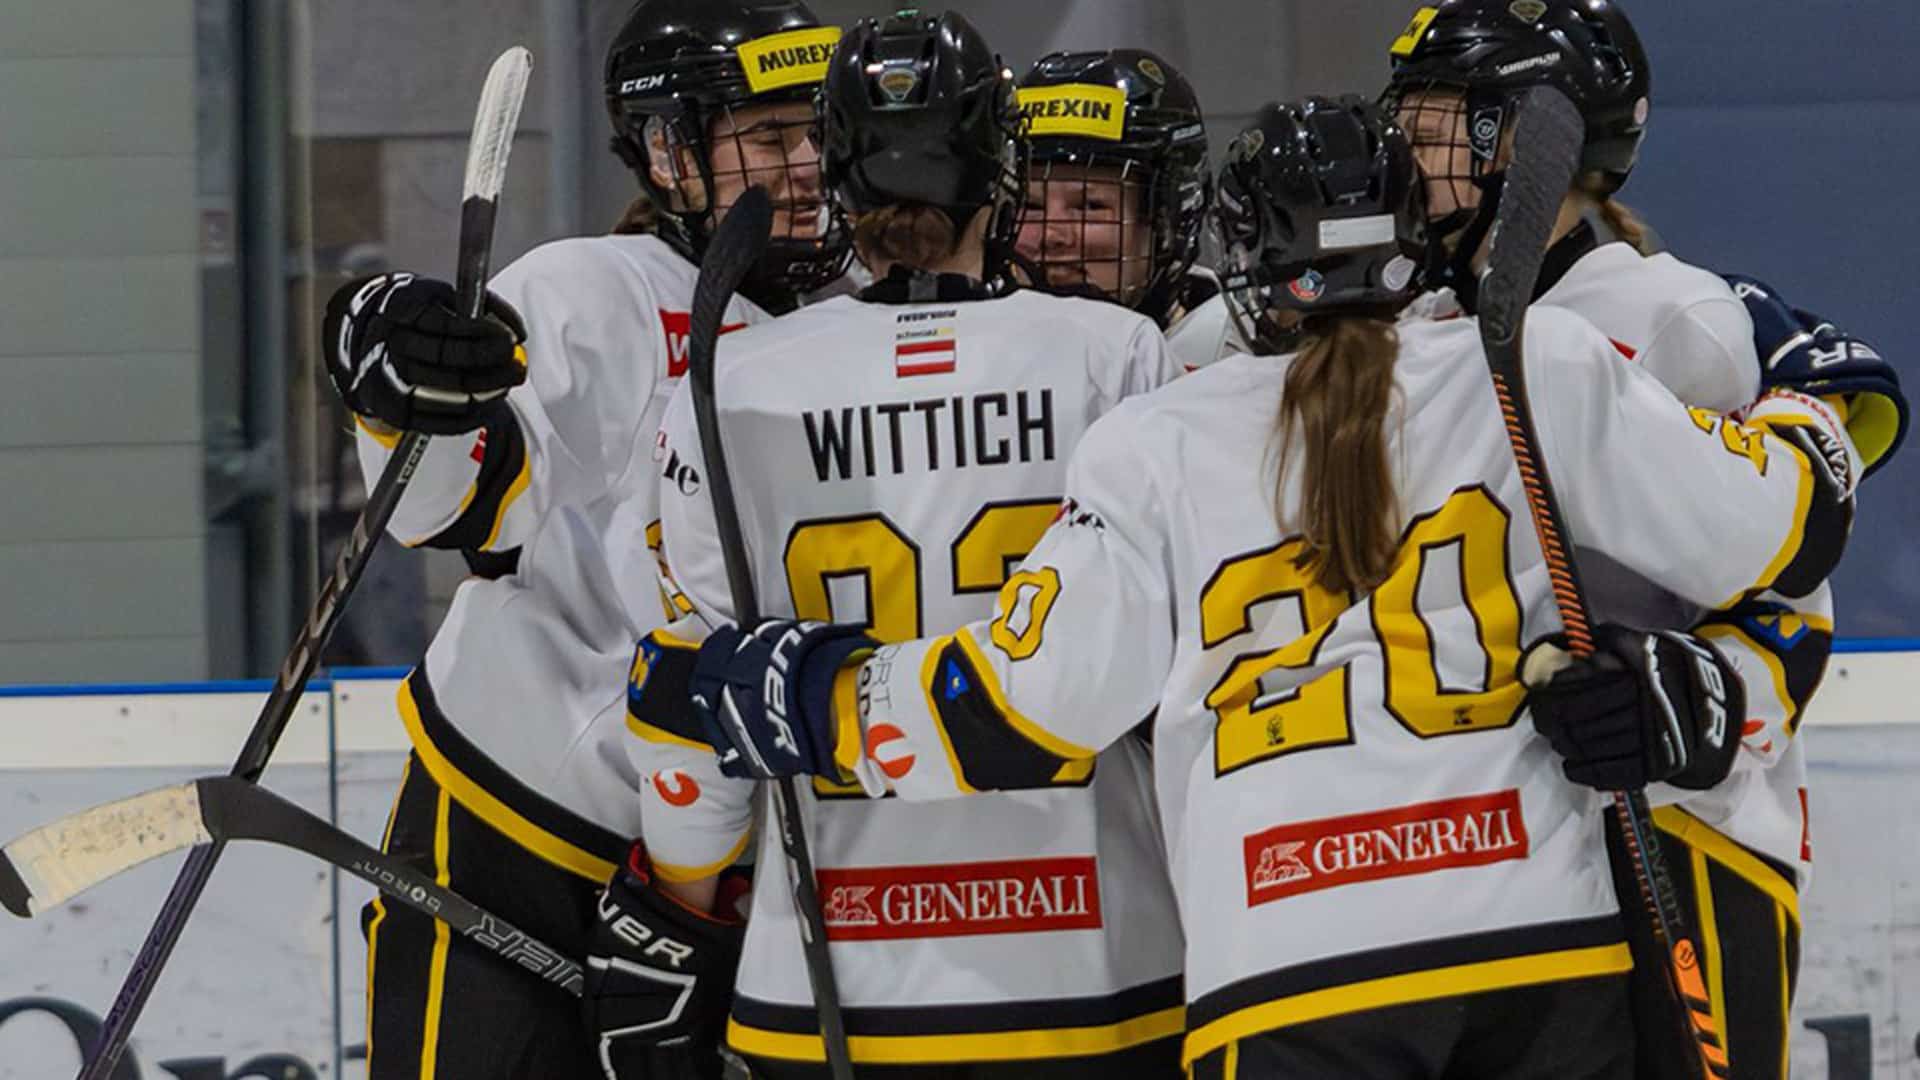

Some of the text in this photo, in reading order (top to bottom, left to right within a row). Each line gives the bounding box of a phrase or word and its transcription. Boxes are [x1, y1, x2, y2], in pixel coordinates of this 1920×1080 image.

[620, 74, 664, 93] CCM
[757, 43, 839, 73] MUREX
[1020, 98, 1112, 121] REXIN
[802, 388, 1056, 483] WITTICH
[1200, 481, 1528, 779] 20
[1312, 807, 1520, 875] GENERALI
[881, 874, 1090, 927] GENERALI
